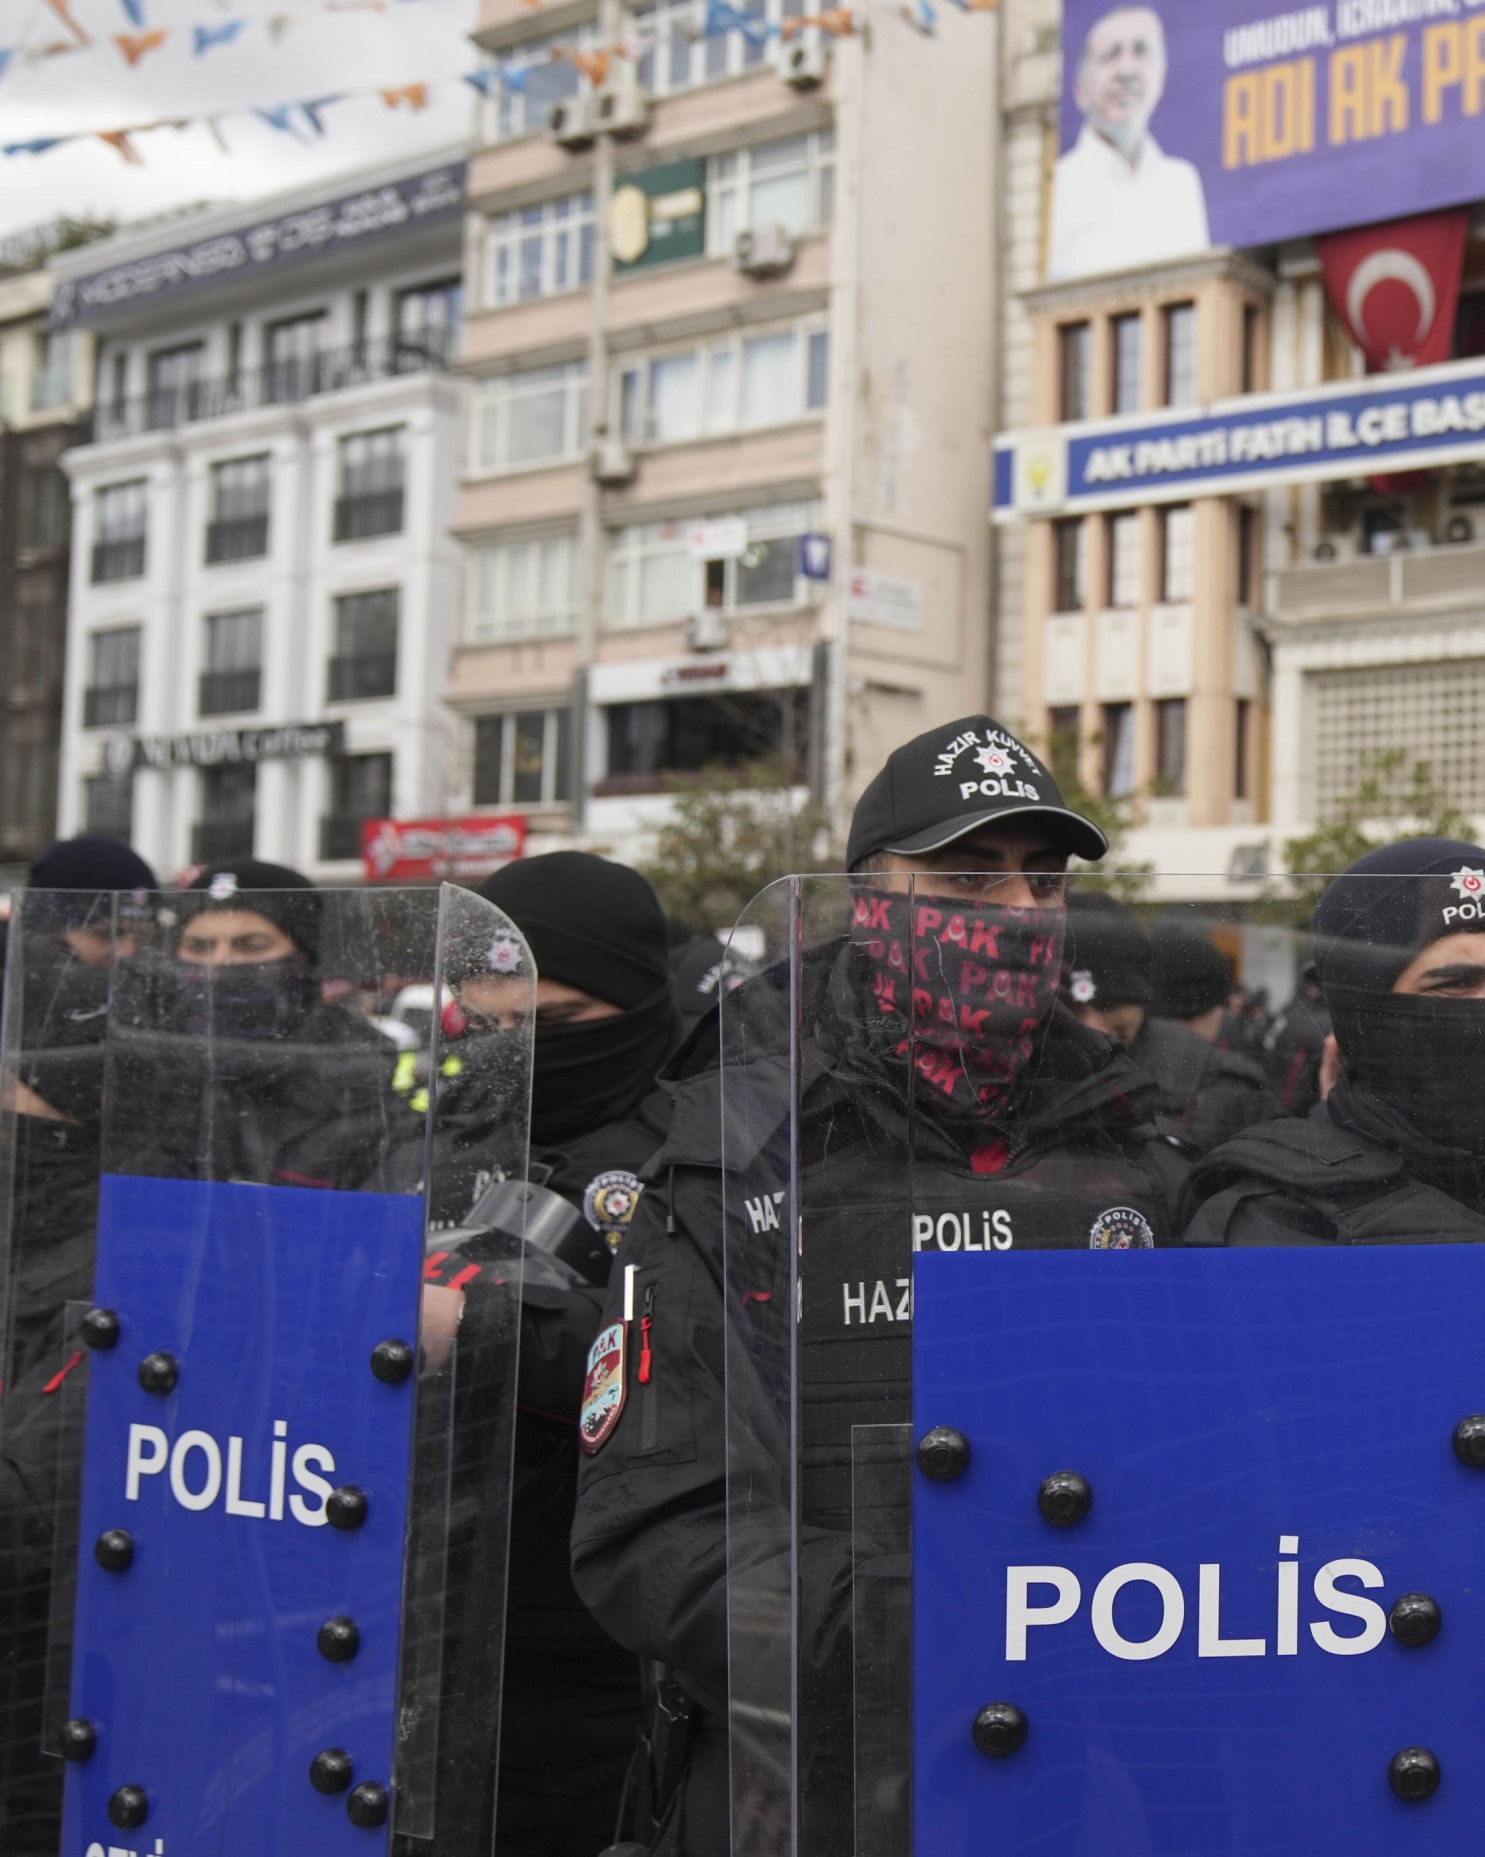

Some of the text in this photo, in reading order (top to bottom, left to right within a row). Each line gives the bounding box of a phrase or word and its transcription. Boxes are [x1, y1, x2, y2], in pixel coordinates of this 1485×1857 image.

[1223, 56, 1315, 170] ADI
[1329, 34, 1409, 146] AK
[1083, 442, 1134, 484] AK
[1135, 429, 1228, 473] PARTİ
[933, 728, 1043, 777] HAZIR KUVVET
[916, 906, 1005, 960] PAK
[959, 959, 1040, 1009] PAK
[913, 986, 992, 1041] PAK
[126, 1420, 336, 1527] POLİS
[1005, 1535, 1387, 1661] POLİS
